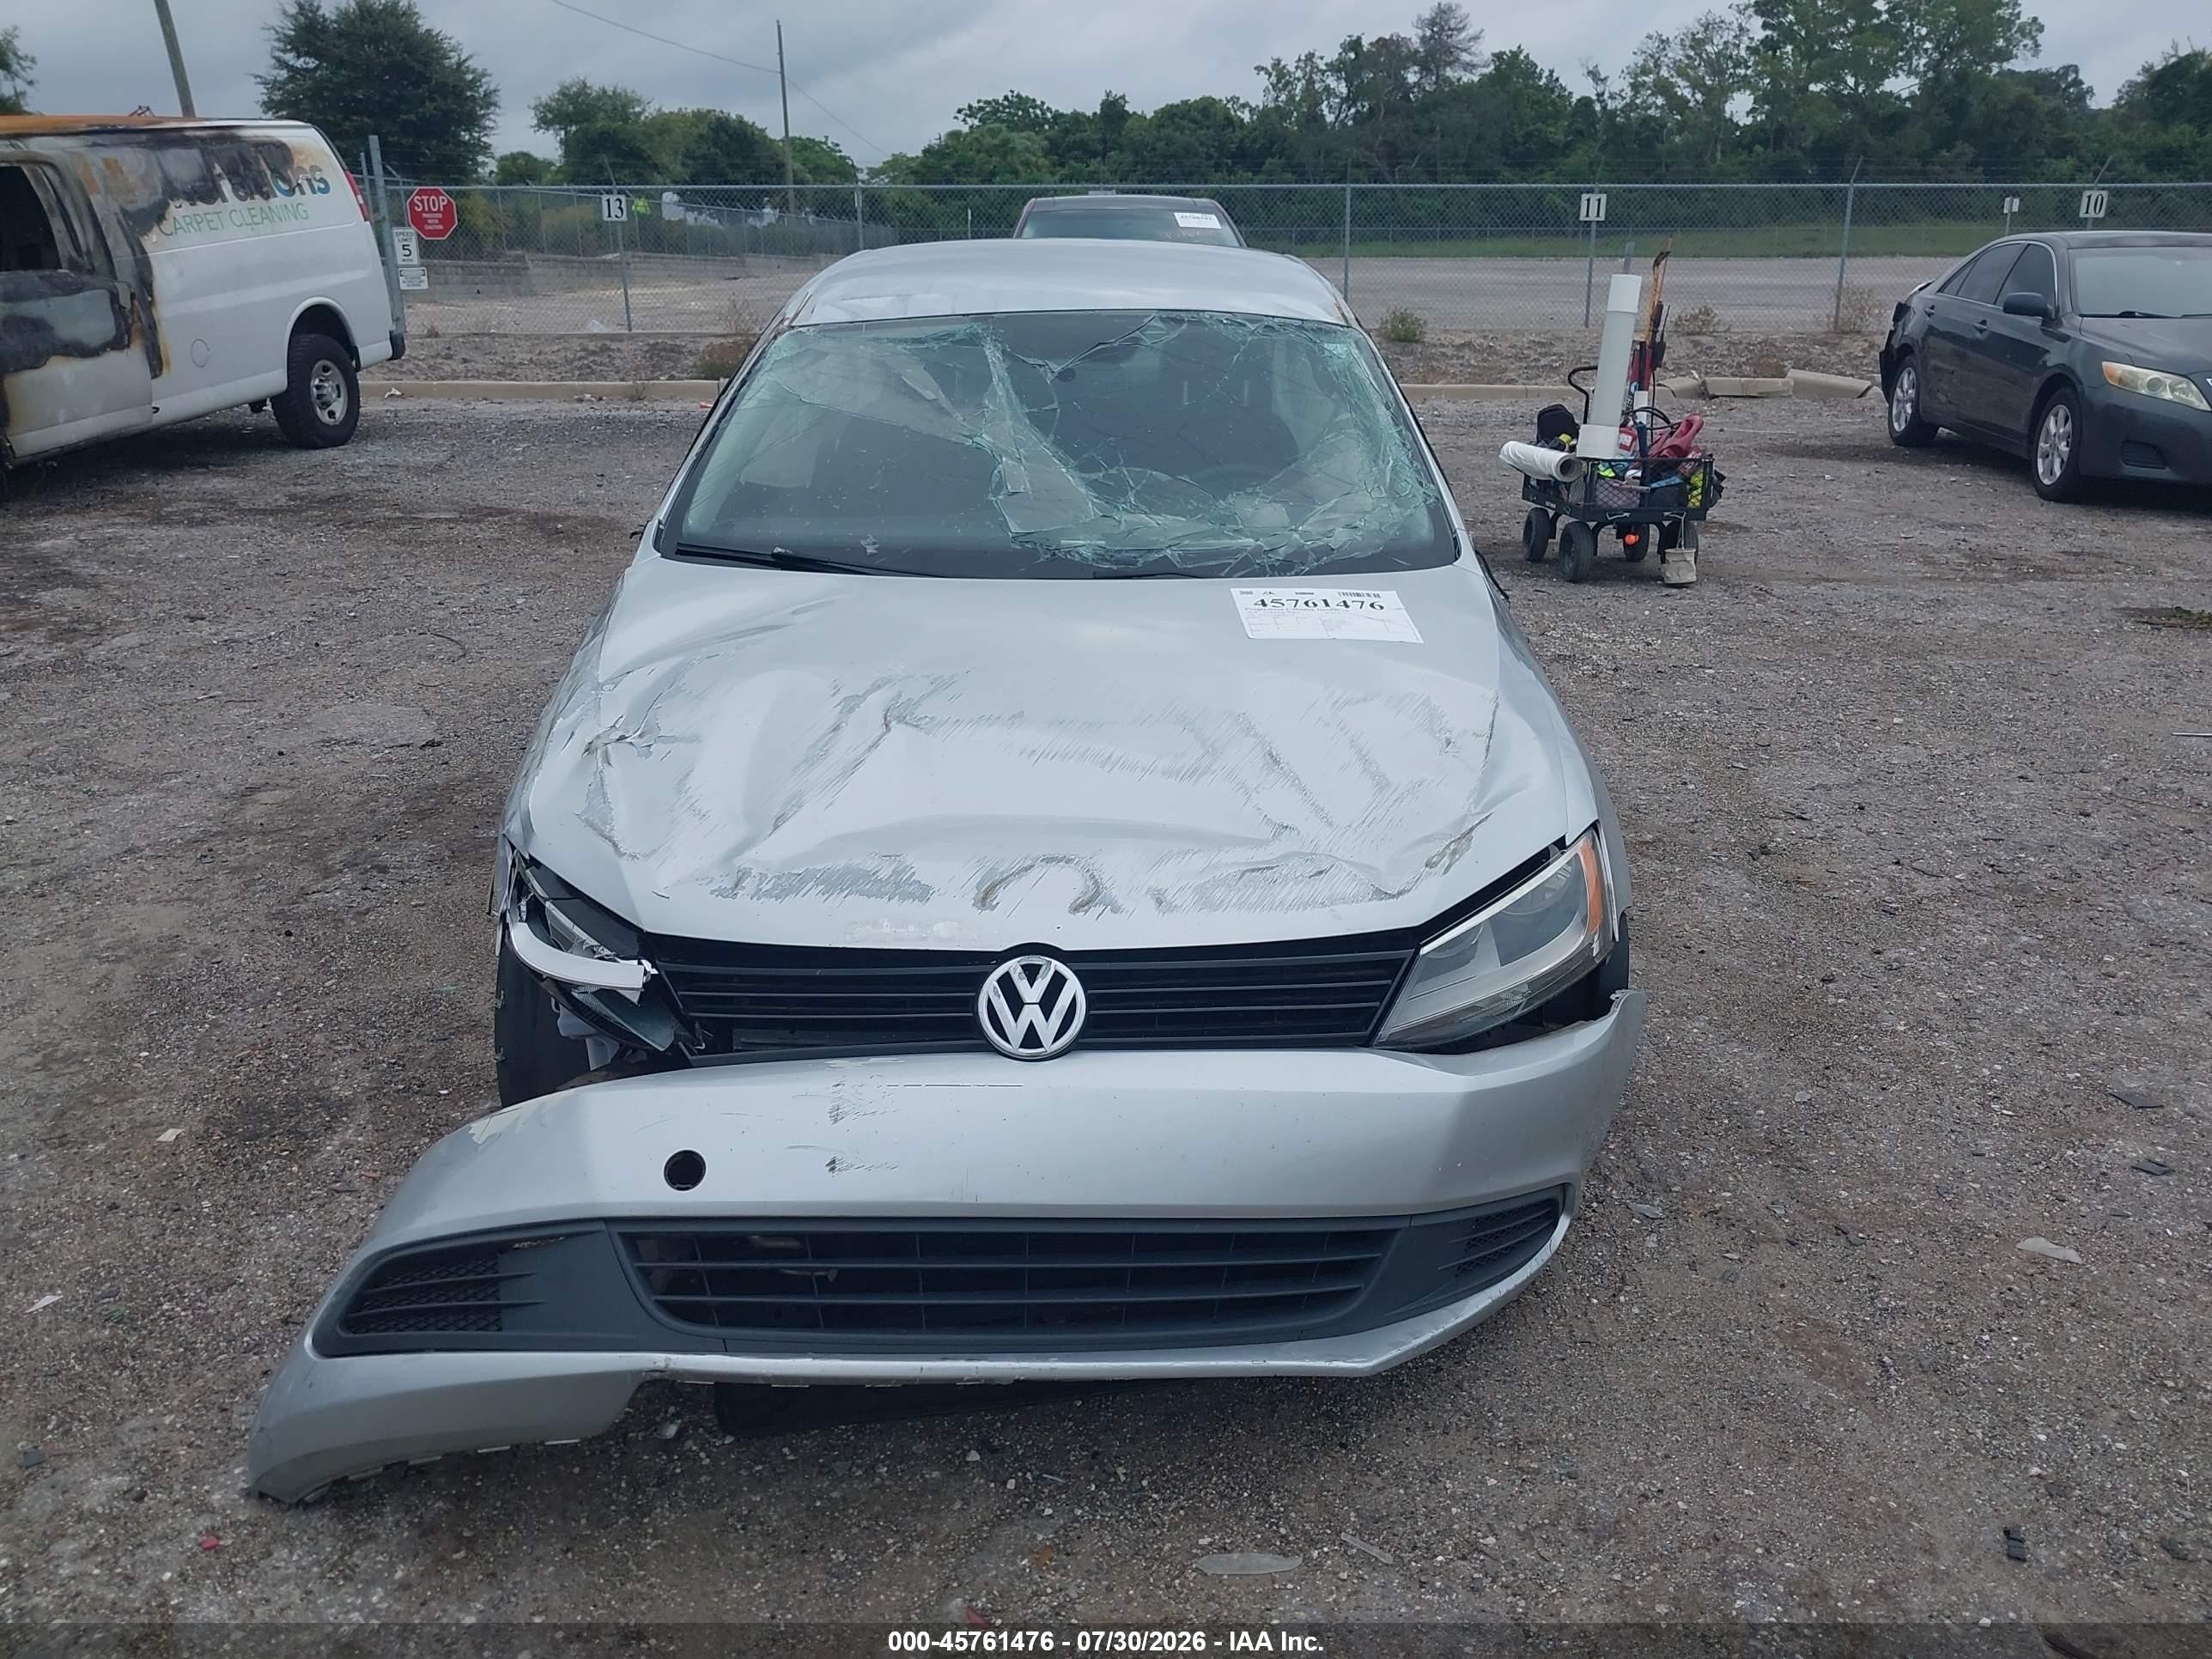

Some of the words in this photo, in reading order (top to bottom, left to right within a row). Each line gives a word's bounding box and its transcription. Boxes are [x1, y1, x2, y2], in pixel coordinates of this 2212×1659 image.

[414, 196, 447, 211] STOP
[605, 198, 623, 218] 13
[1584, 198, 1601, 217] 11
[2083, 193, 2104, 215] 10
[157, 211, 225, 237] CARPET
[228, 203, 309, 228] CLEANING
[402, 244, 412, 258] 5
[1253, 599, 1385, 611] 45761476
